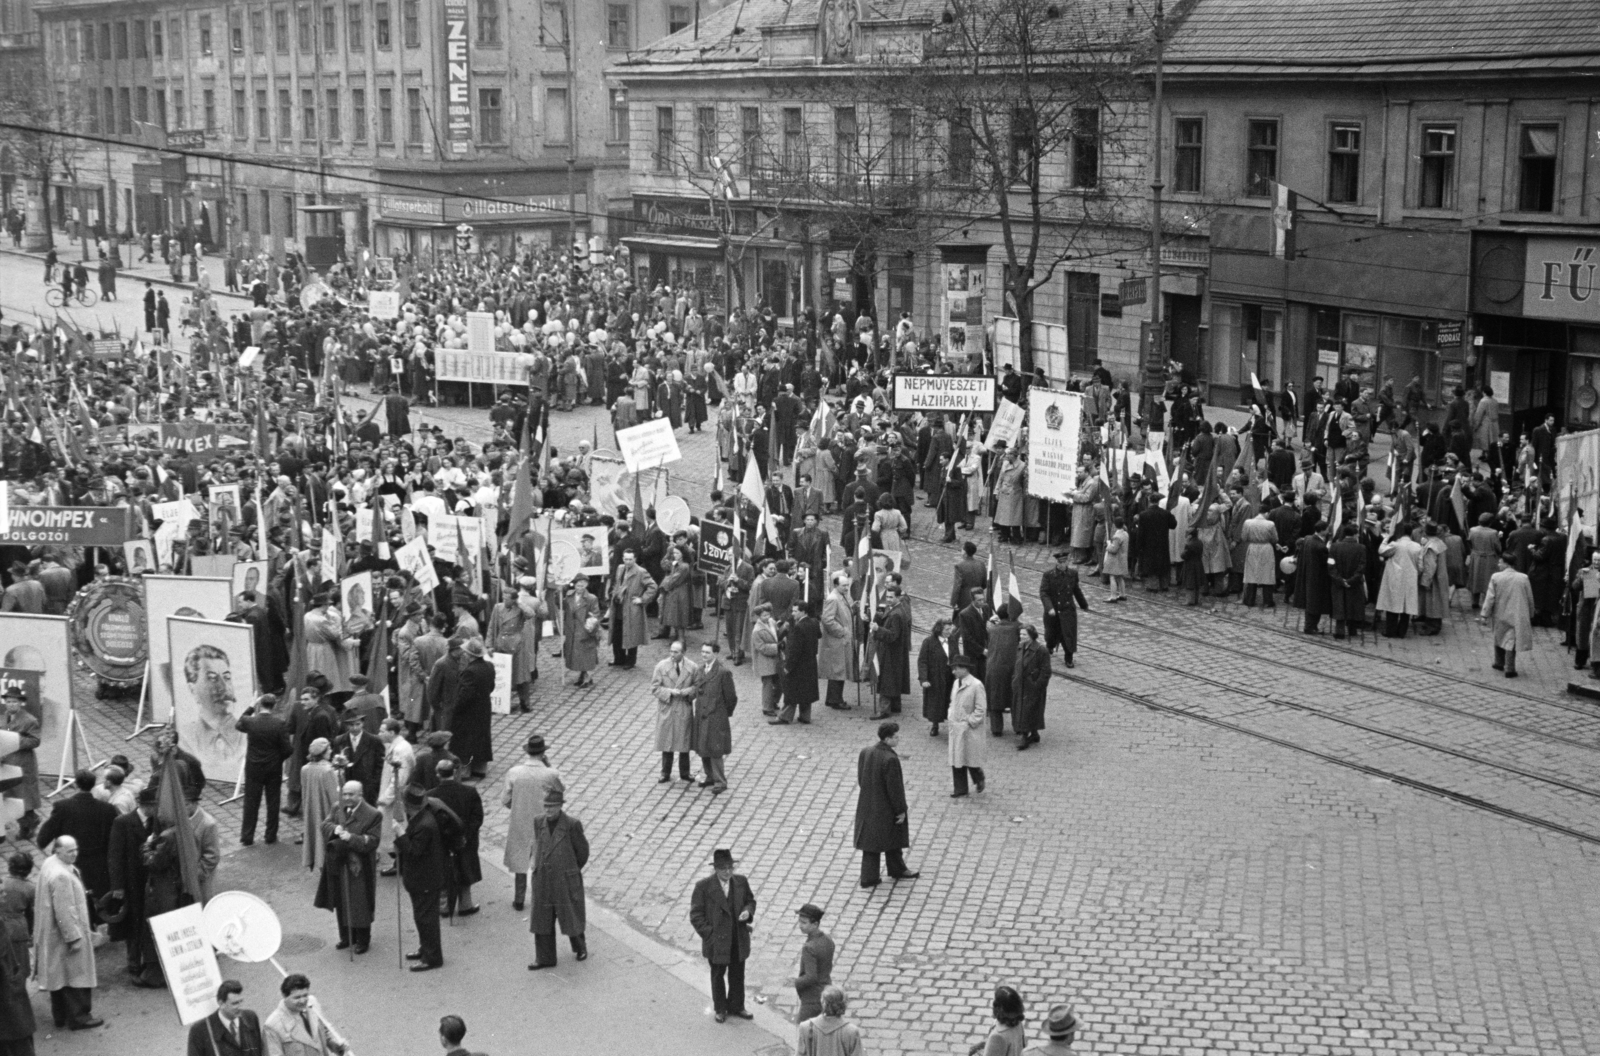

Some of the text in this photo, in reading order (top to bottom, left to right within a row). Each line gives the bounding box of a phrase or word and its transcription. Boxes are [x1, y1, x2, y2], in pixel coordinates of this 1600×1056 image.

[447, 20, 467, 102] ZENE
[475, 198, 556, 214] illatszerbolt
[164, 434, 213, 453] NIKEX
[8, 510, 95, 528] HNOIMPEX
